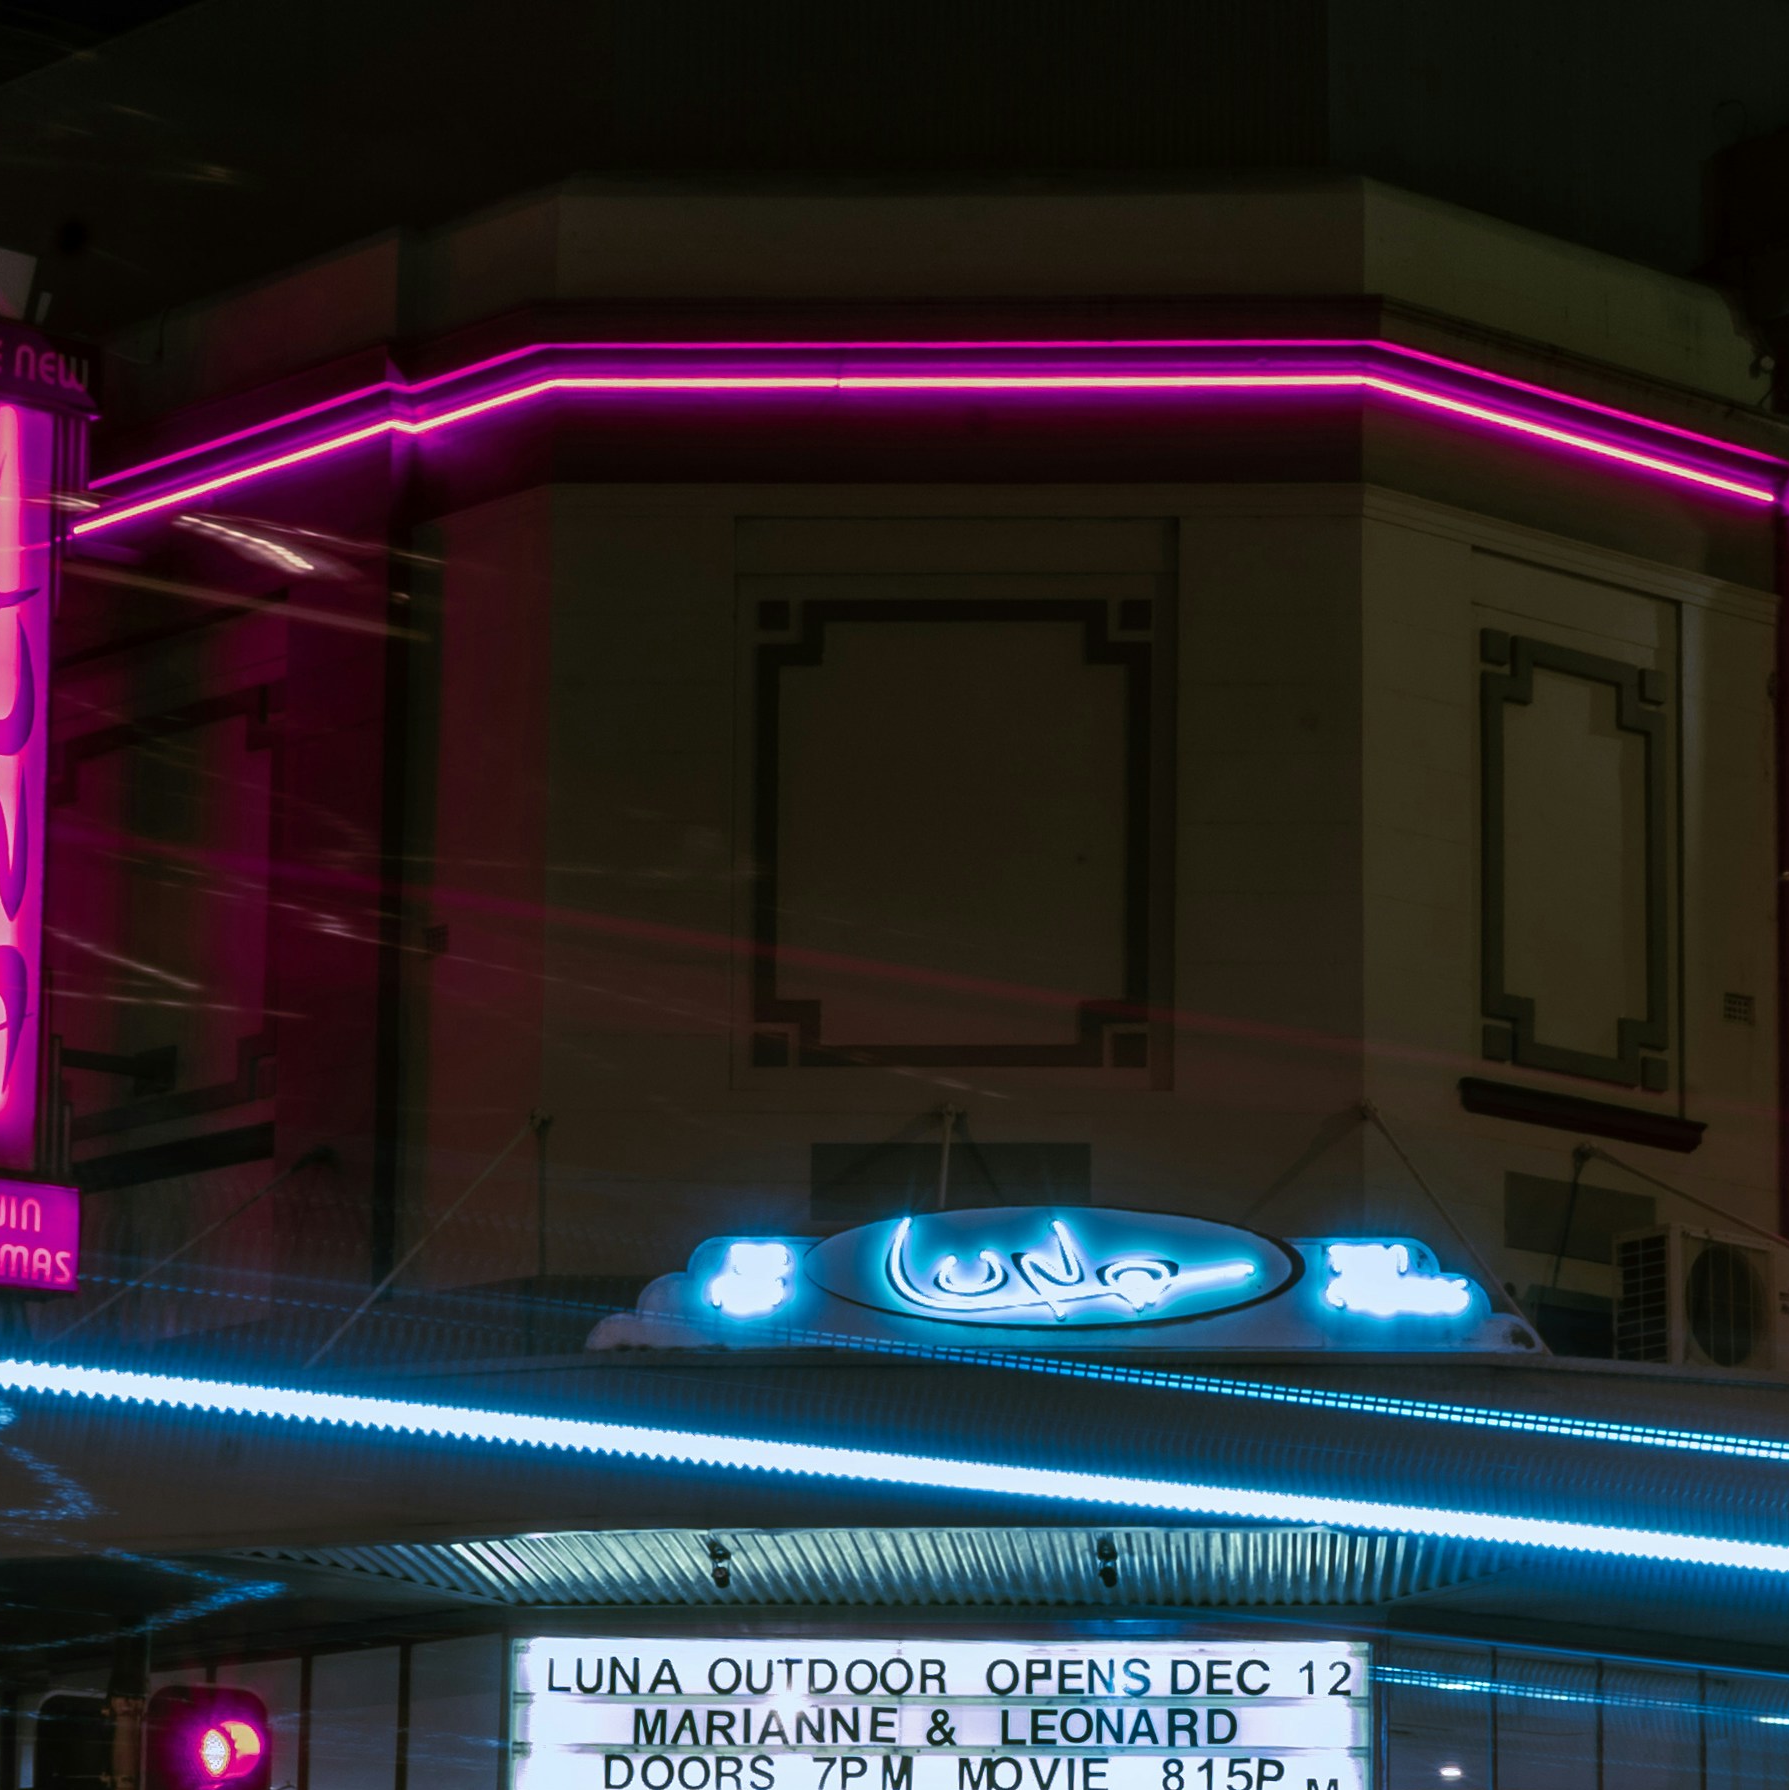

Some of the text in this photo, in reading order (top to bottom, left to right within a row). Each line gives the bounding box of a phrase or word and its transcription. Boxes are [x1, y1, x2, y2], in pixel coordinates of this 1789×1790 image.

[15, 344, 89, 392] NEW
[548, 1656, 1352, 1697] LUNA OUTDOOR OPENS DEC 12
[633, 1707, 1238, 1747] MARIANNE & LEONARD
